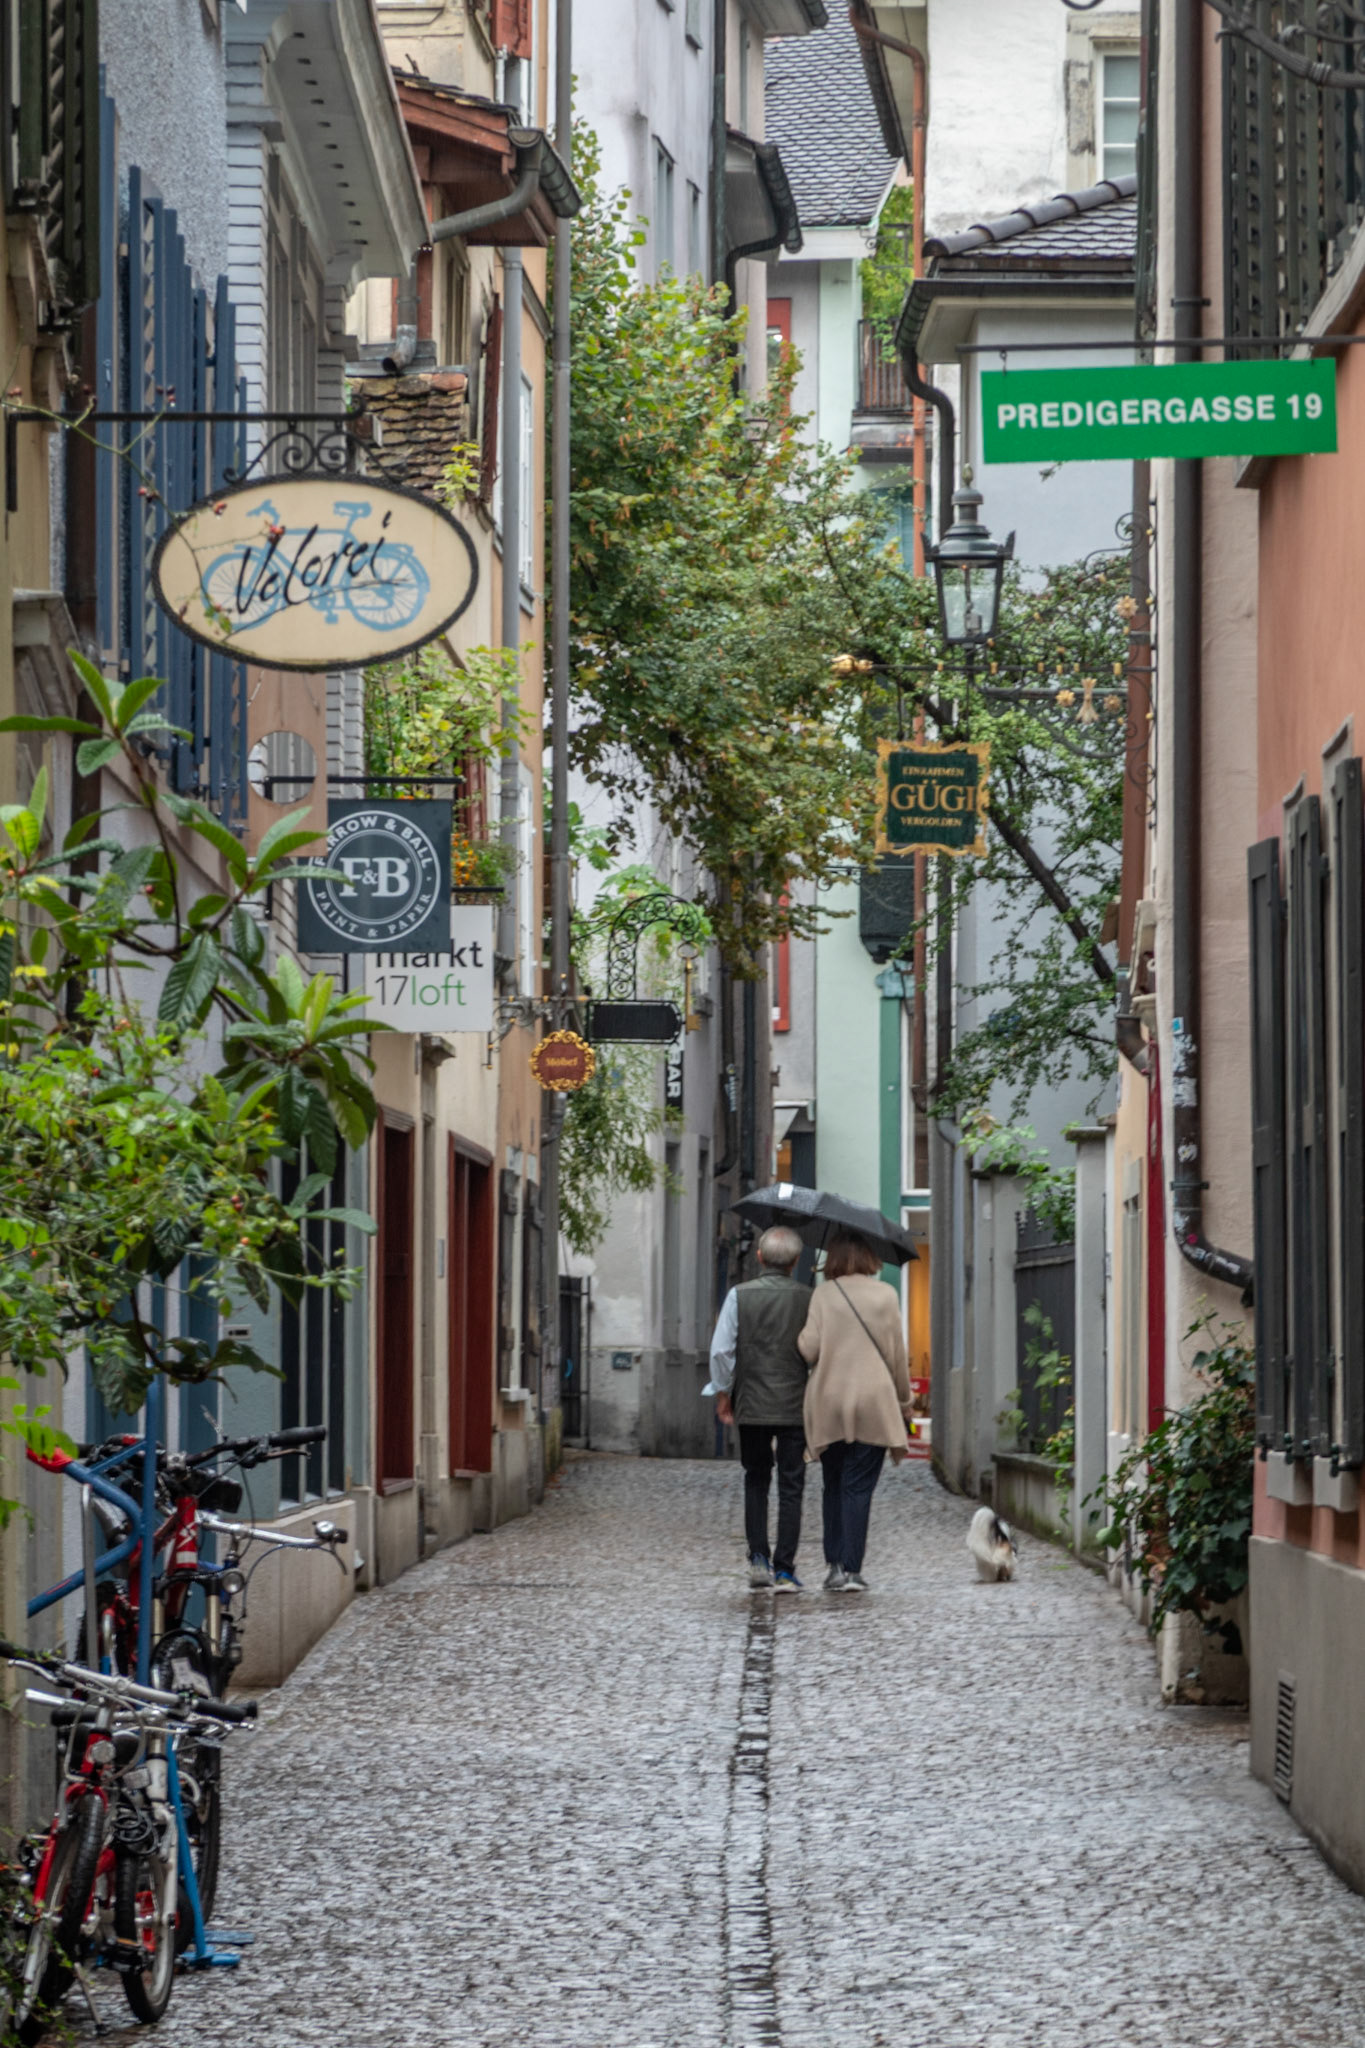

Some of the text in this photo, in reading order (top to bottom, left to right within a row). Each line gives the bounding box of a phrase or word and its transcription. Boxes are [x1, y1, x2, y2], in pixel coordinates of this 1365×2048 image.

[997, 393, 1323, 429] PREDIGERGASSE 19
[891, 779, 976, 812] GÜGI
[901, 816, 963, 827] VERGOLDEN
[314, 815, 433, 868] FRROW & BALL
[339, 857, 410, 897] F&B
[316, 891, 431, 938] PAINT & PAPER
